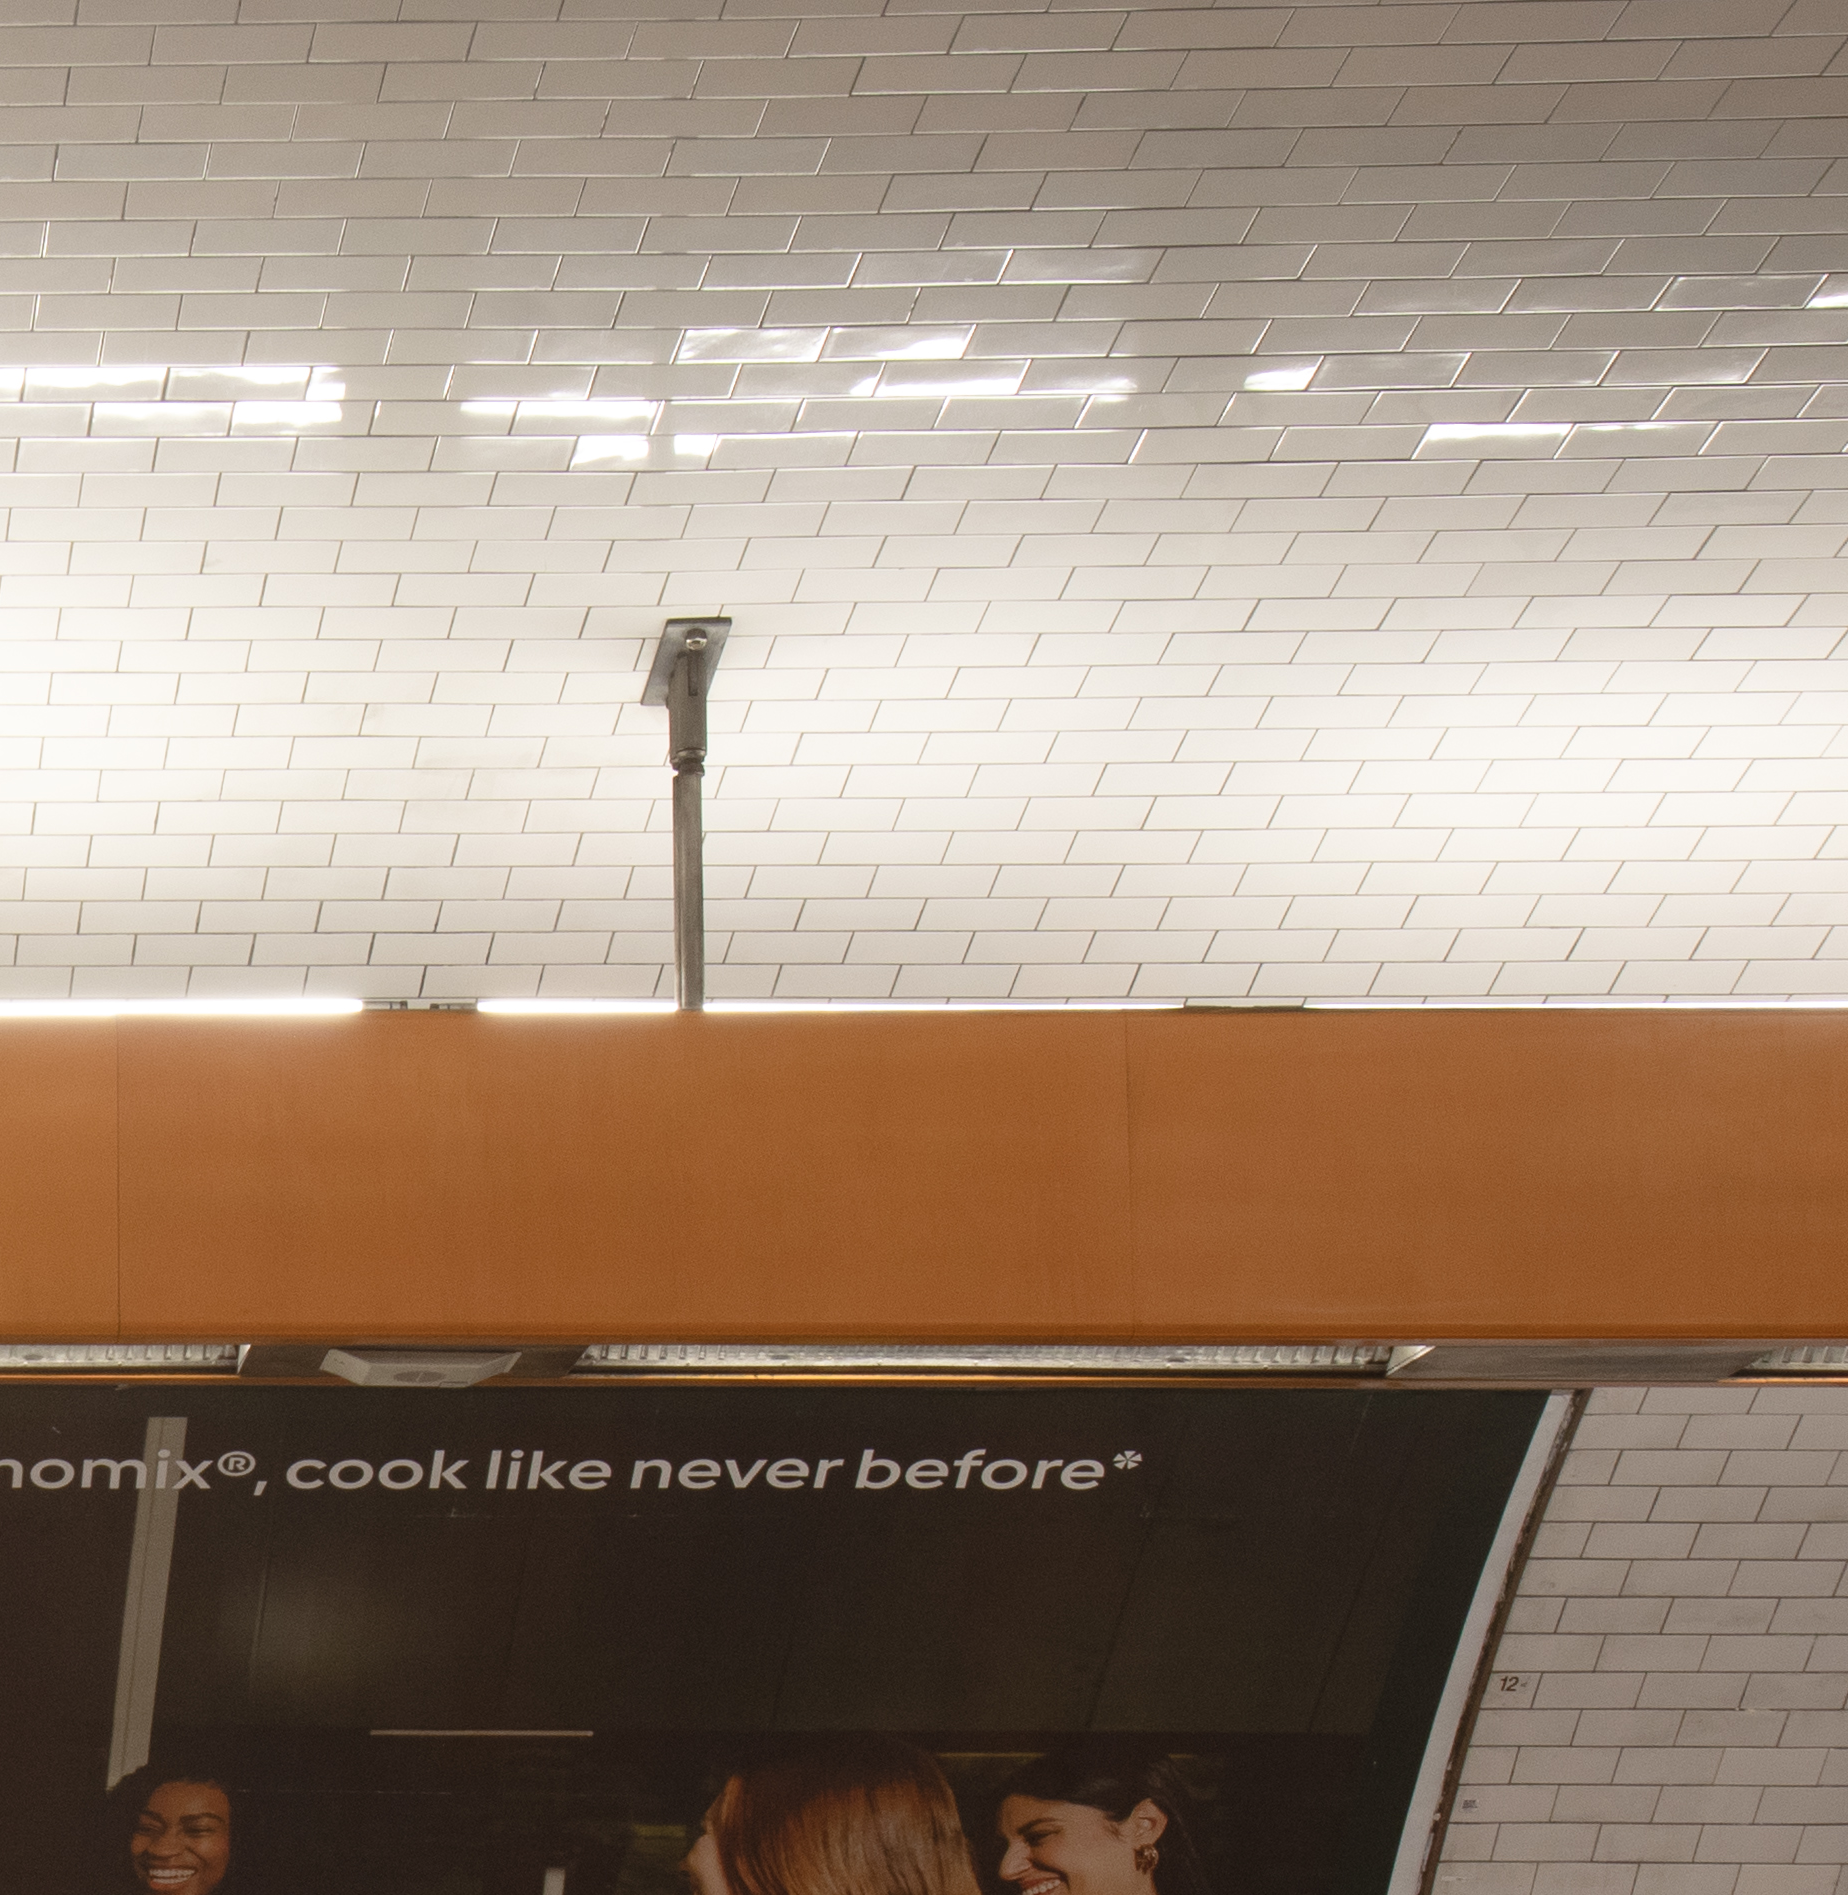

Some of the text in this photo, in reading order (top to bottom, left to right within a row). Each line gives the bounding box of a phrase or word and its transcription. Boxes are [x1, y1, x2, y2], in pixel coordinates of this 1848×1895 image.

[287, 1450, 468, 1490] cook
[486, 1450, 611, 1490] like
[630, 1458, 844, 1489] never
[1500, 1676, 1519, 1692] 12
